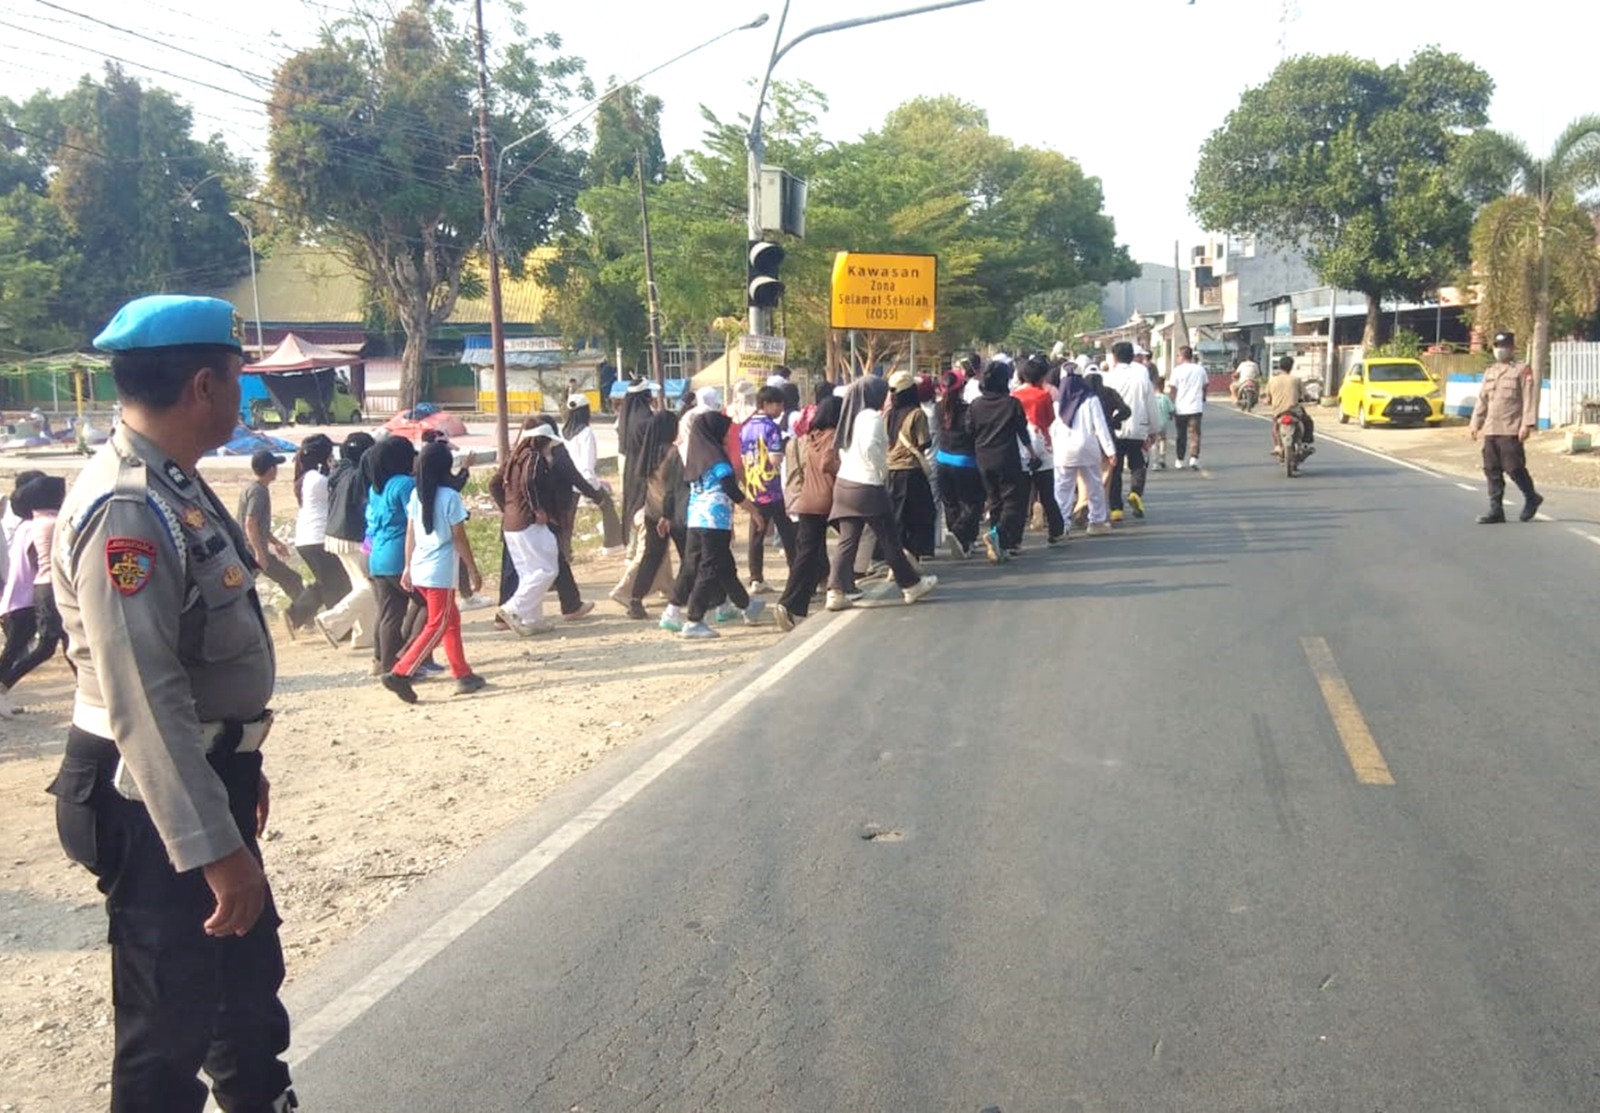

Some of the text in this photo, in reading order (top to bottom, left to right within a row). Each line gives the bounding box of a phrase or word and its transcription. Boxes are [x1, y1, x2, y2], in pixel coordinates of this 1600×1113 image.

[848, 265, 919, 278] Kawasan
[870, 280, 896, 292] Zona
[839, 293, 928, 307] Selamat Sekolah
[866, 308, 898, 321] (ZOSS)
